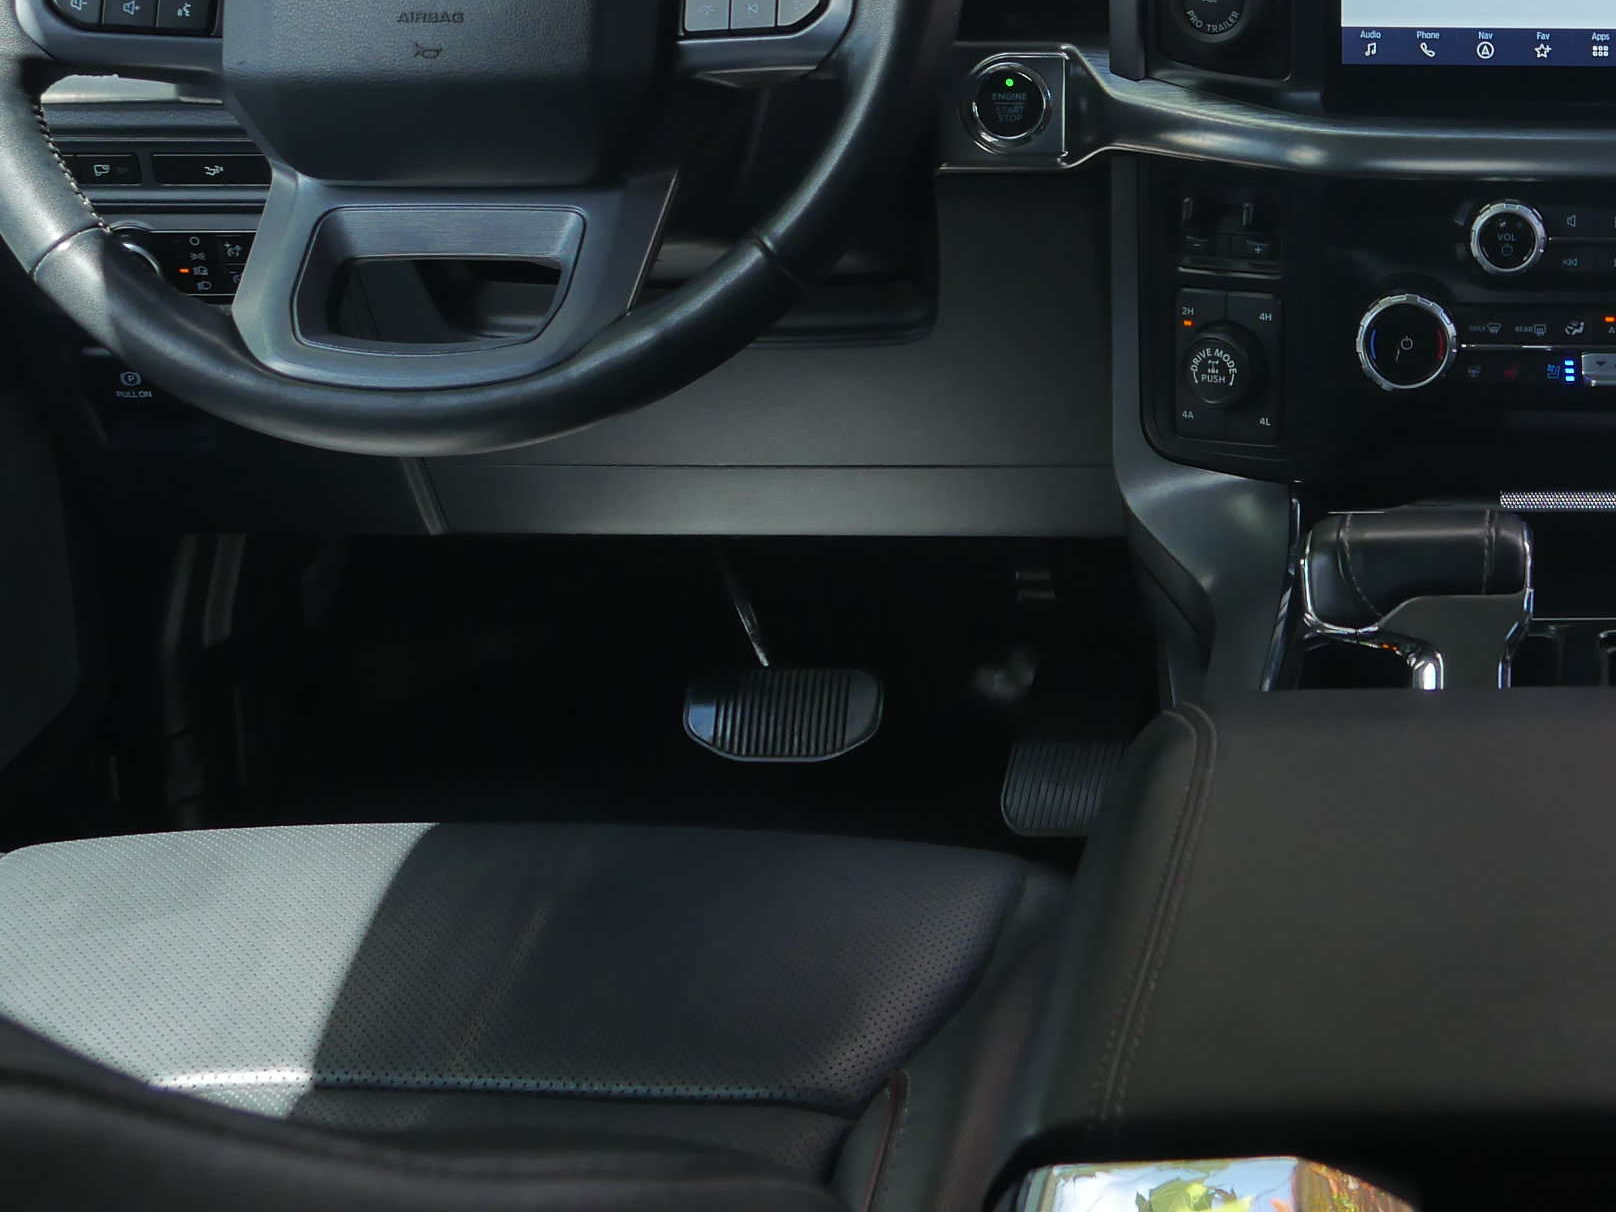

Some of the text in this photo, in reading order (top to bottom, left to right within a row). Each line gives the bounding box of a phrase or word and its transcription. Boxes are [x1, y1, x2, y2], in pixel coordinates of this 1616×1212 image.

[396, 11, 465, 23] AIRBAG
[1186, 10, 1240, 33] PRO TRAILER
[1360, 30, 1382, 39] Audio
[1416, 30, 1440, 40] Phone
[1478, 31, 1493, 40] Nav
[1536, 31, 1550, 41] Fav
[1592, 32, 1610, 42] Apps
[992, 92, 1028, 101] ENGINE
[997, 105, 1025, 114] START
[998, 114, 1023, 122] STOP
[1497, 232, 1516, 241] VOL
[1182, 307, 1194, 316] 2H
[1259, 313, 1272, 322] 4H
[1190, 348, 1237, 375] DRIVE MODE
[1201, 374, 1226, 384] PUSH
[138, 390, 153, 398] ON
[1182, 410, 1194, 419] 4A
[1259, 417, 1271, 426] 4L
